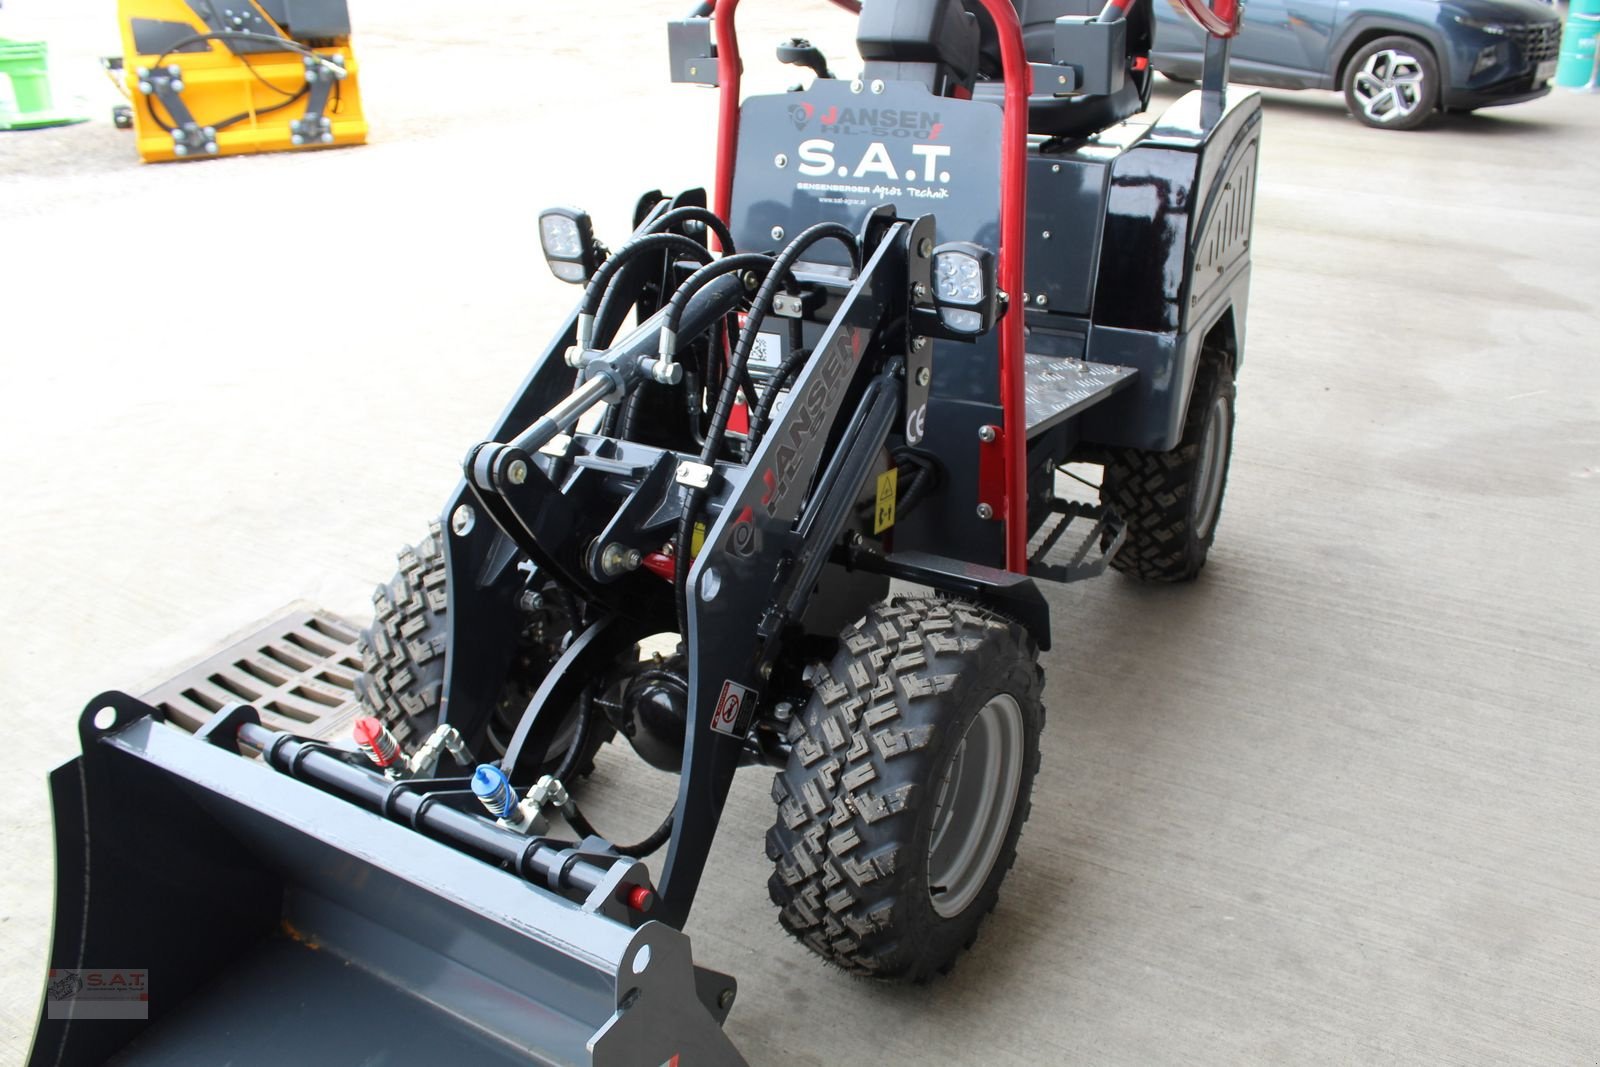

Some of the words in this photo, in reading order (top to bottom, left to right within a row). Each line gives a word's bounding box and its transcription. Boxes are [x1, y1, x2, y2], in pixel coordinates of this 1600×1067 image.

[820, 105, 941, 129] JANSEN
[798, 138, 951, 184] S.A.T.
[761, 322, 856, 506] JANSEN
